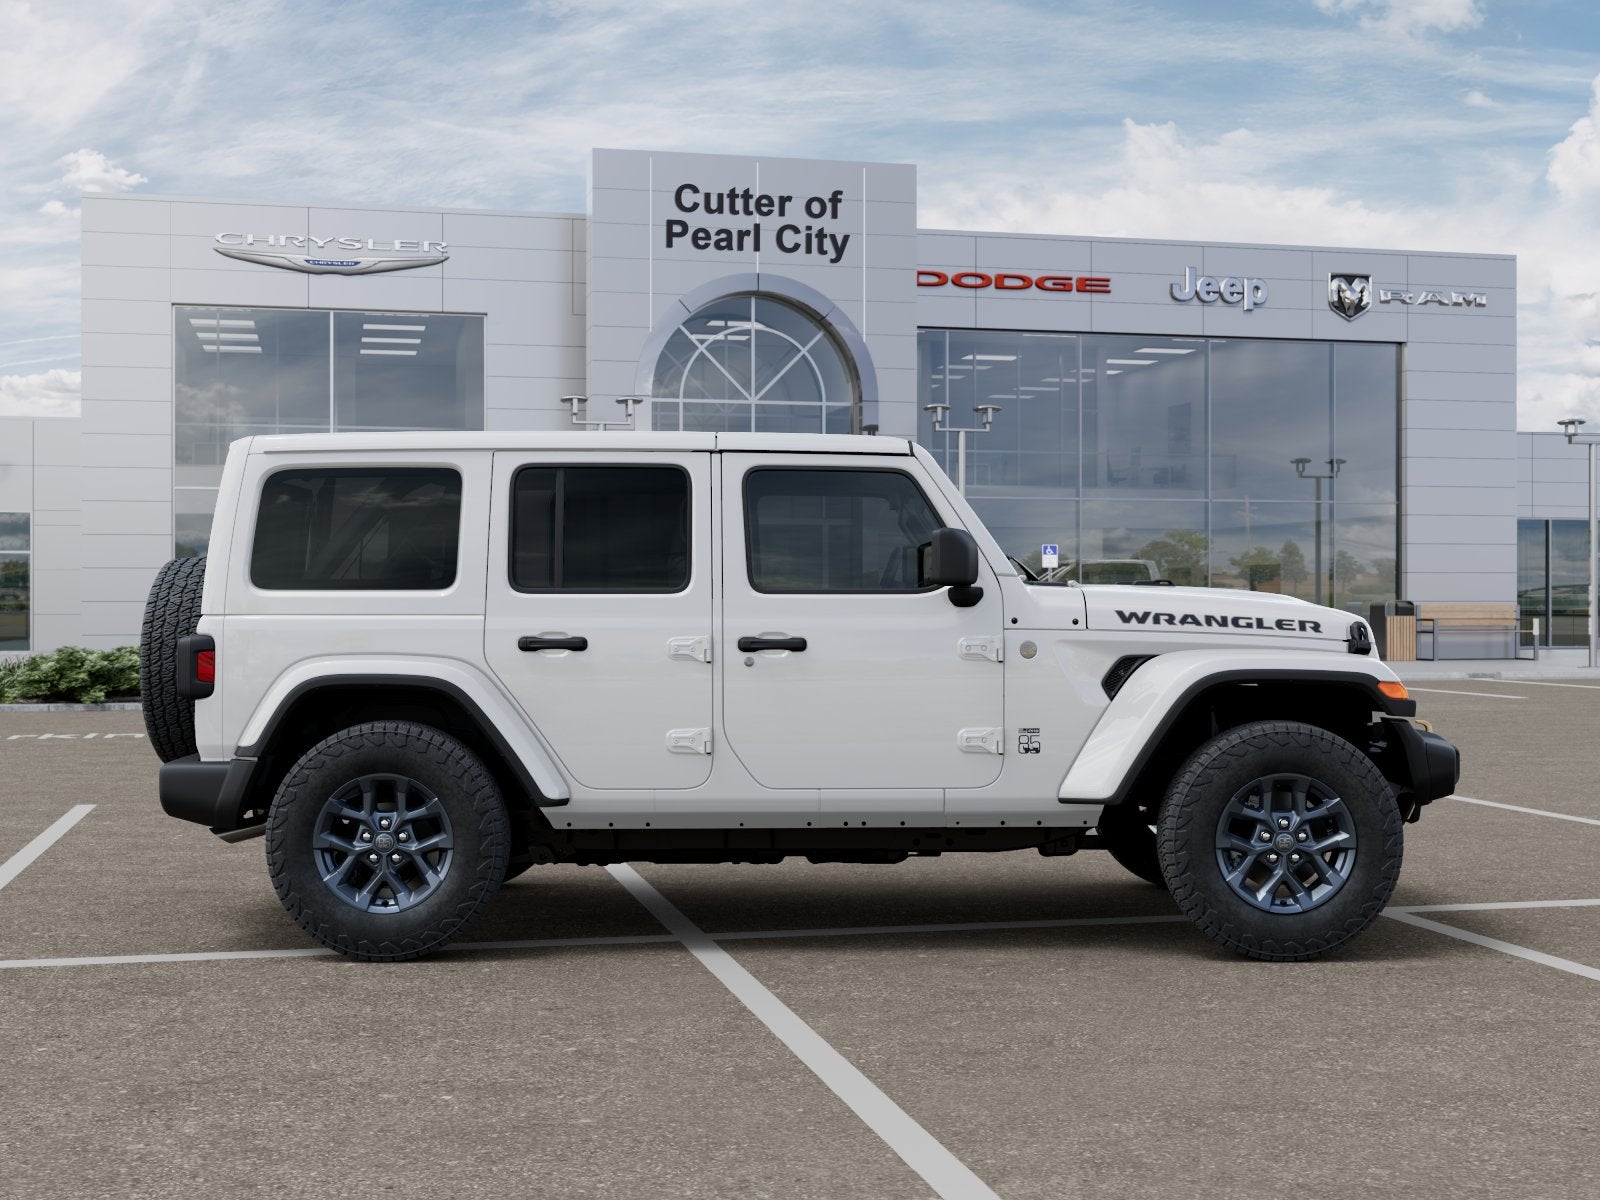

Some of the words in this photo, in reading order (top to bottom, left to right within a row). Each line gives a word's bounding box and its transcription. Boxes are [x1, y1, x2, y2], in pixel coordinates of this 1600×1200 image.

[674, 183, 793, 217] Cutter
[804, 190, 844, 219] of
[214, 232, 449, 253] CHRYSLER
[665, 219, 761, 252] Pearl
[775, 224, 850, 264] City
[917, 270, 1112, 294] DODGE
[1169, 266, 1270, 311] Jeep
[1379, 289, 1488, 308] RAM
[1114, 609, 1324, 633] WRANGLER
